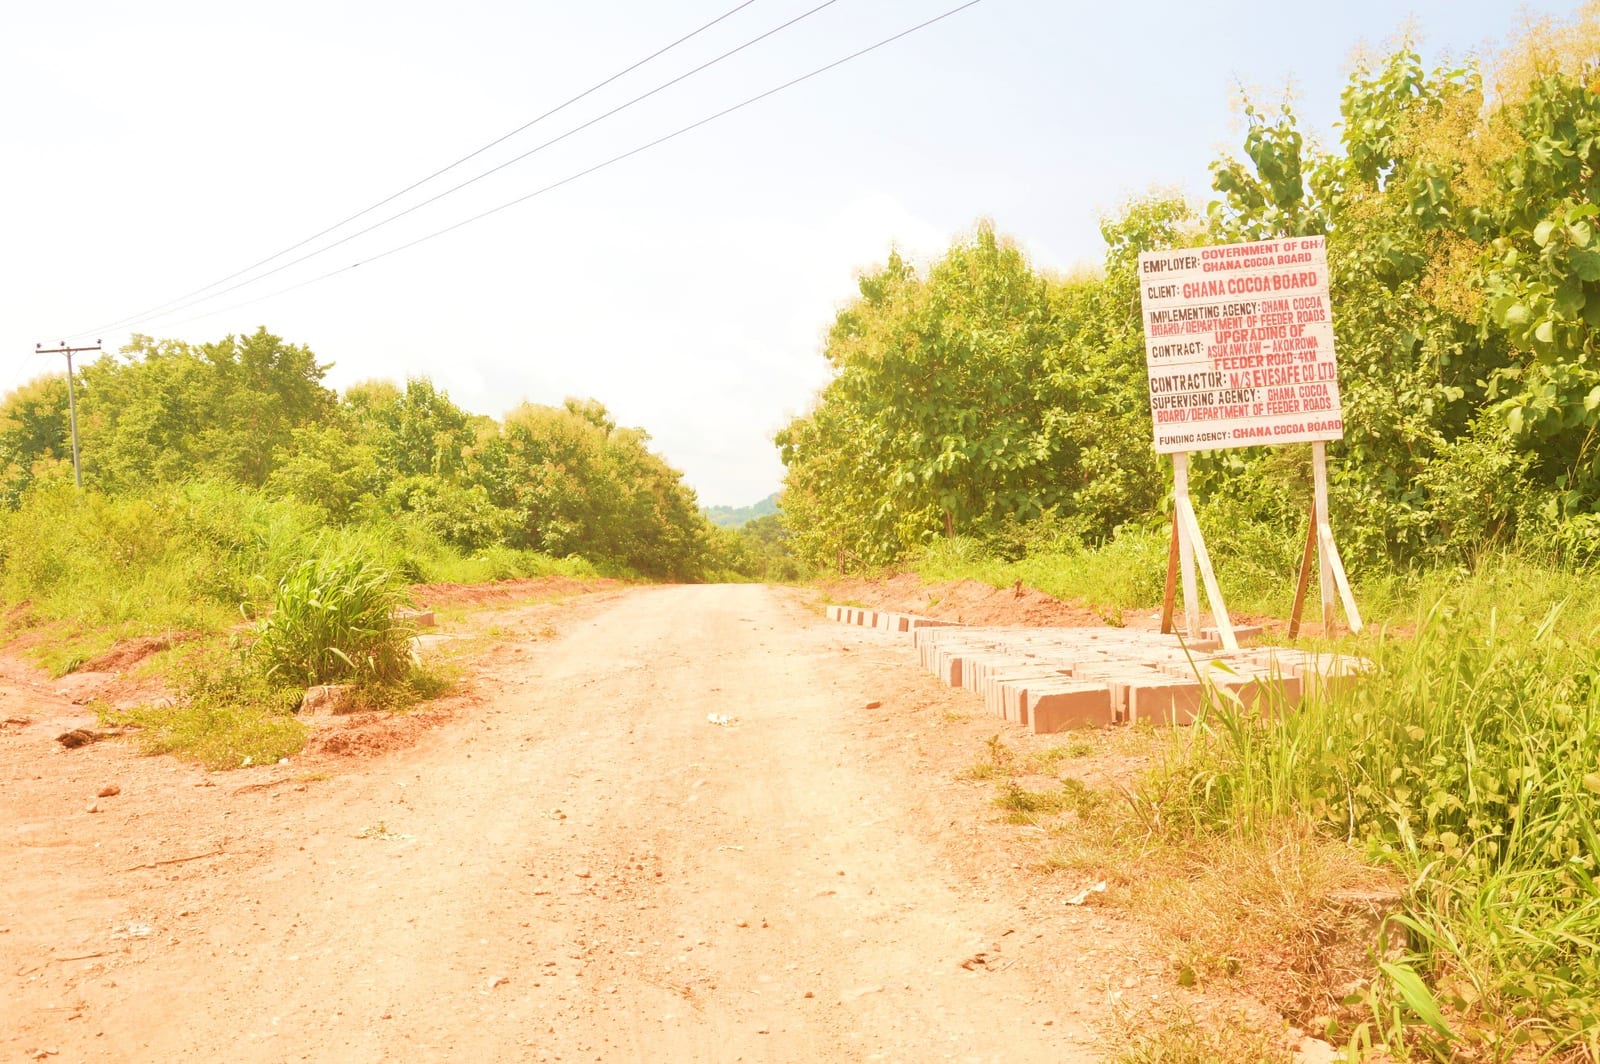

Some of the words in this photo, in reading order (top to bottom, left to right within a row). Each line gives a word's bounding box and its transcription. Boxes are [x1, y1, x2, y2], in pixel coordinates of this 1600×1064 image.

[1202, 244, 1278, 260] GOVERNMENT
[1284, 242, 1297, 250] OF
[1203, 260, 1241, 272] GHANA
[1244, 256, 1274, 268] COCOA
[1278, 252, 1312, 264] BOARD
[1144, 257, 1200, 273] EMPLOYER:
[1148, 285, 1179, 299] CLIENT:
[1183, 280, 1225, 298] GHANA
[1228, 276, 1270, 294] COCOA
[1273, 272, 1317, 290] BOARD
[1150, 306, 1220, 323] IMPLEMENTING
[1223, 302, 1260, 316] AGENCY:
[1262, 299, 1289, 313] GHANA
[1293, 296, 1322, 310] COCOA
[1151, 317, 1243, 336] BOARD/DEPARTMENT
[1247, 315, 1258, 326] OF
[1261, 312, 1293, 326] FEEDER
[1297, 310, 1325, 322] ROADS
[1215, 325, 1286, 344] UPGRADING
[1290, 324, 1305, 337] OF
[1152, 342, 1204, 358] CONTRACT:
[1208, 341, 1261, 358] ASUKAWKAW
[1272, 336, 1318, 352] AKOKROWA
[1214, 356, 1264, 370] FEEDER
[1151, 372, 1226, 393] CONTRACTOR:
[1229, 372, 1250, 389] M/S
[1318, 362, 1334, 380] LTD
[1152, 392, 1214, 409] SUPERVISING
[1218, 389, 1260, 404] AGENCY:
[1268, 387, 1295, 401] GHANA
[1300, 384, 1328, 398] COCOA
[1157, 405, 1249, 422] BOARD/DEPARTMENT
[1253, 403, 1264, 415] OF
[1267, 400, 1300, 414] FEEDER
[1304, 397, 1331, 410] ROADS
[1160, 435, 1194, 445] FUNDING
[1196, 432, 1230, 442] AGENCY:
[1233, 427, 1272, 438] GHANA
[1274, 423, 1305, 434] COCOA
[1307, 420, 1342, 431] BOARD
